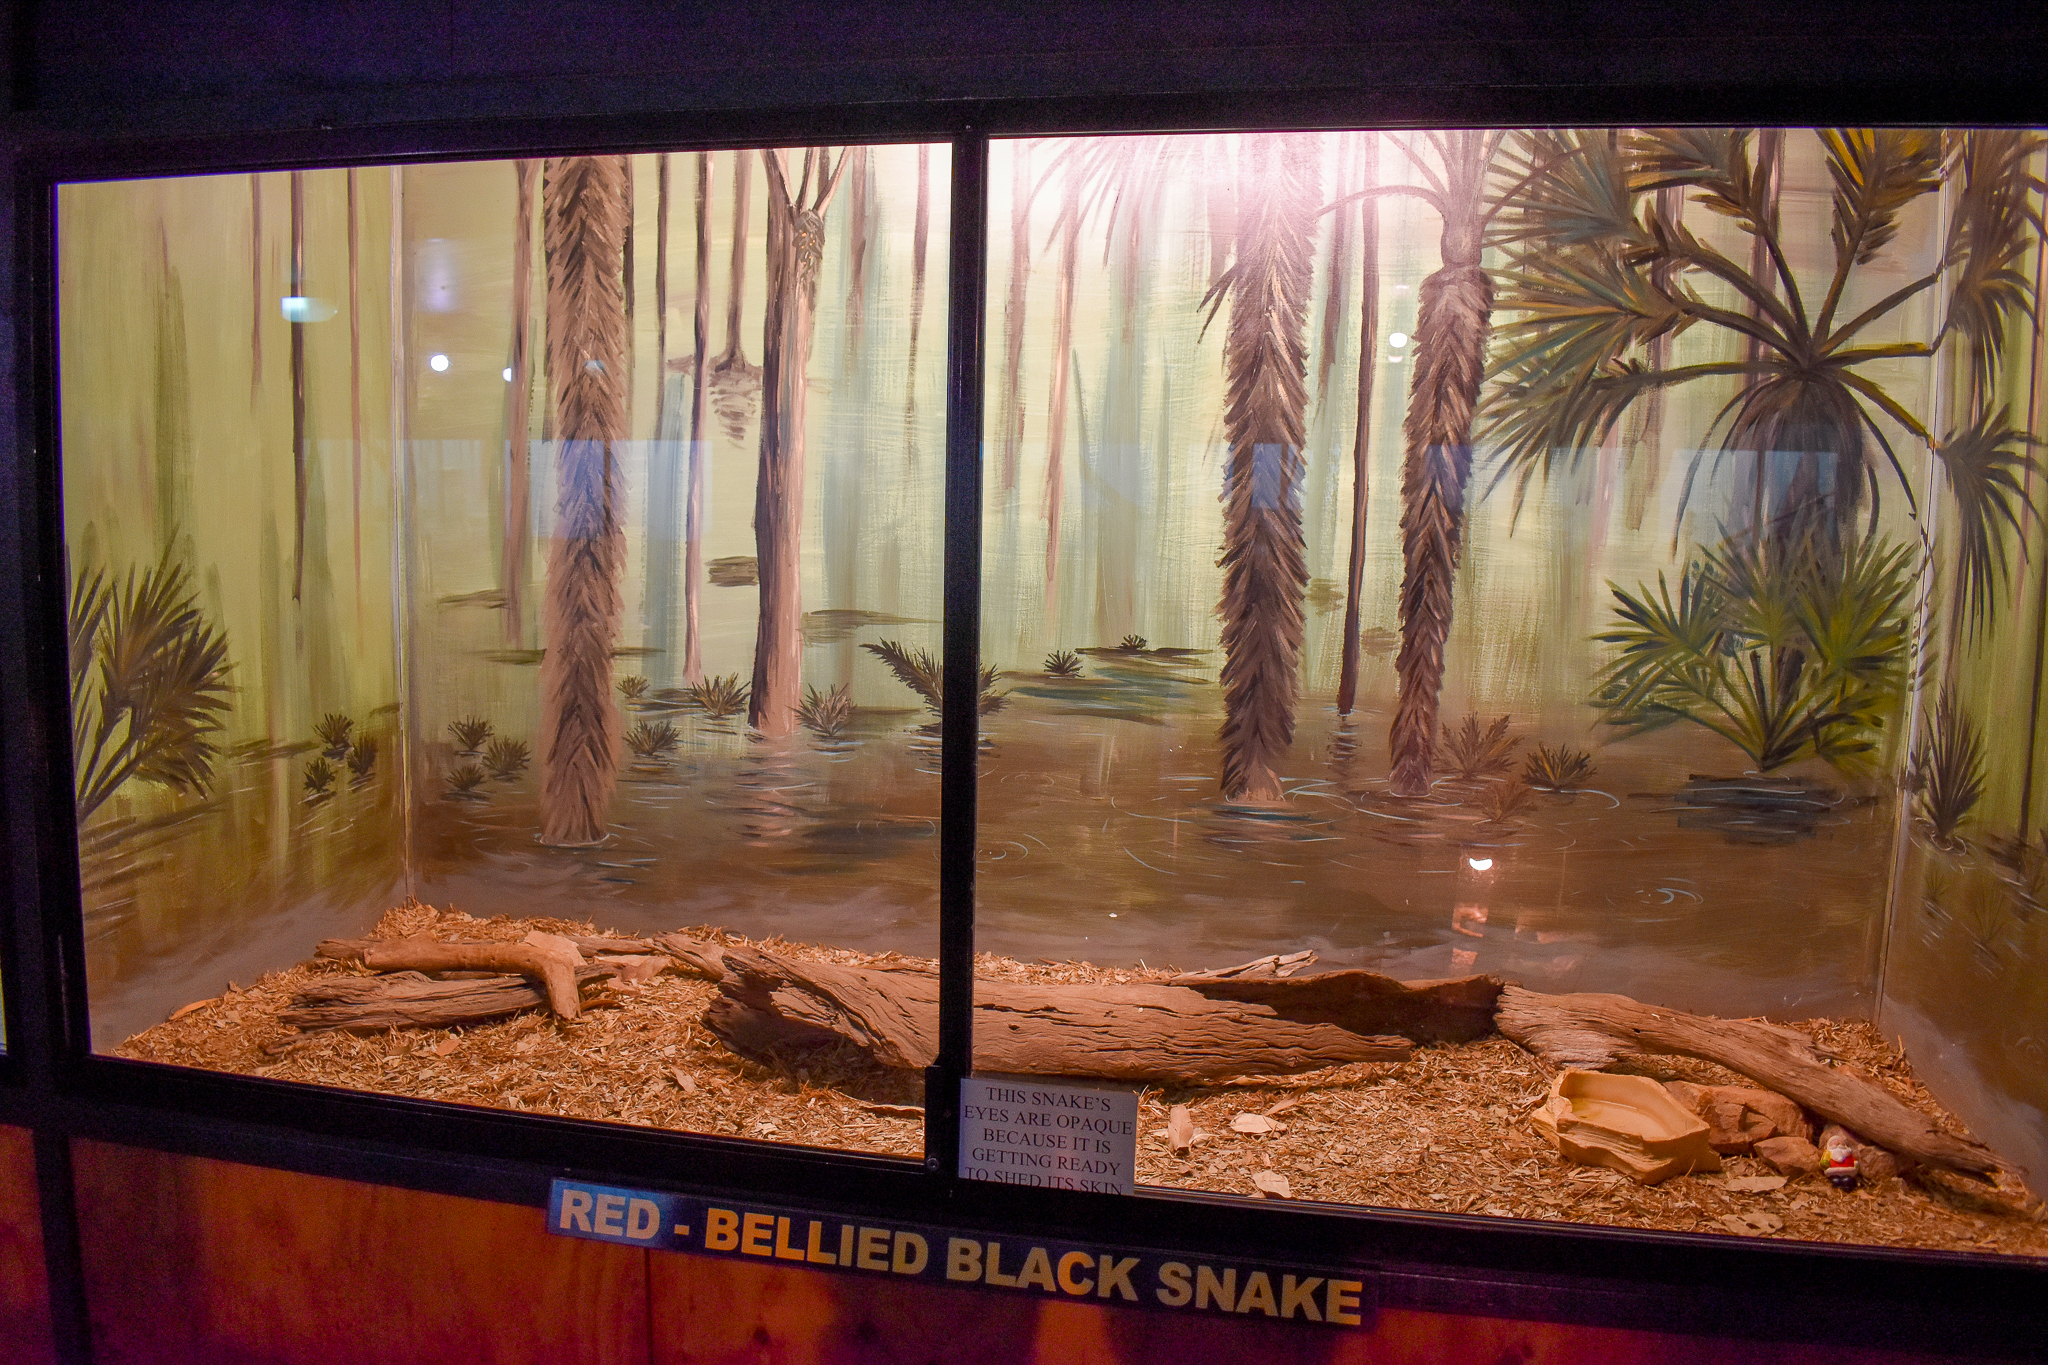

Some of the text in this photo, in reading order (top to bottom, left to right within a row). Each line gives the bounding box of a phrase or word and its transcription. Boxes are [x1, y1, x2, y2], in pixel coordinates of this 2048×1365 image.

[986, 1087, 1026, 1104] THIS
[964, 1105, 1133, 1136] EYES ARE OPAQUE
[983, 1128, 1111, 1154] BECAUSE IT IS
[972, 1147, 1121, 1175] GETTING READY
[965, 1167, 1123, 1195] TO SHED ITS SKIN
[559, 1188, 660, 1240] RED
[704, 1207, 929, 1275] BELLIED
[946, 1237, 1140, 1302] BLACK
[1156, 1261, 1363, 1326] SNAKE
